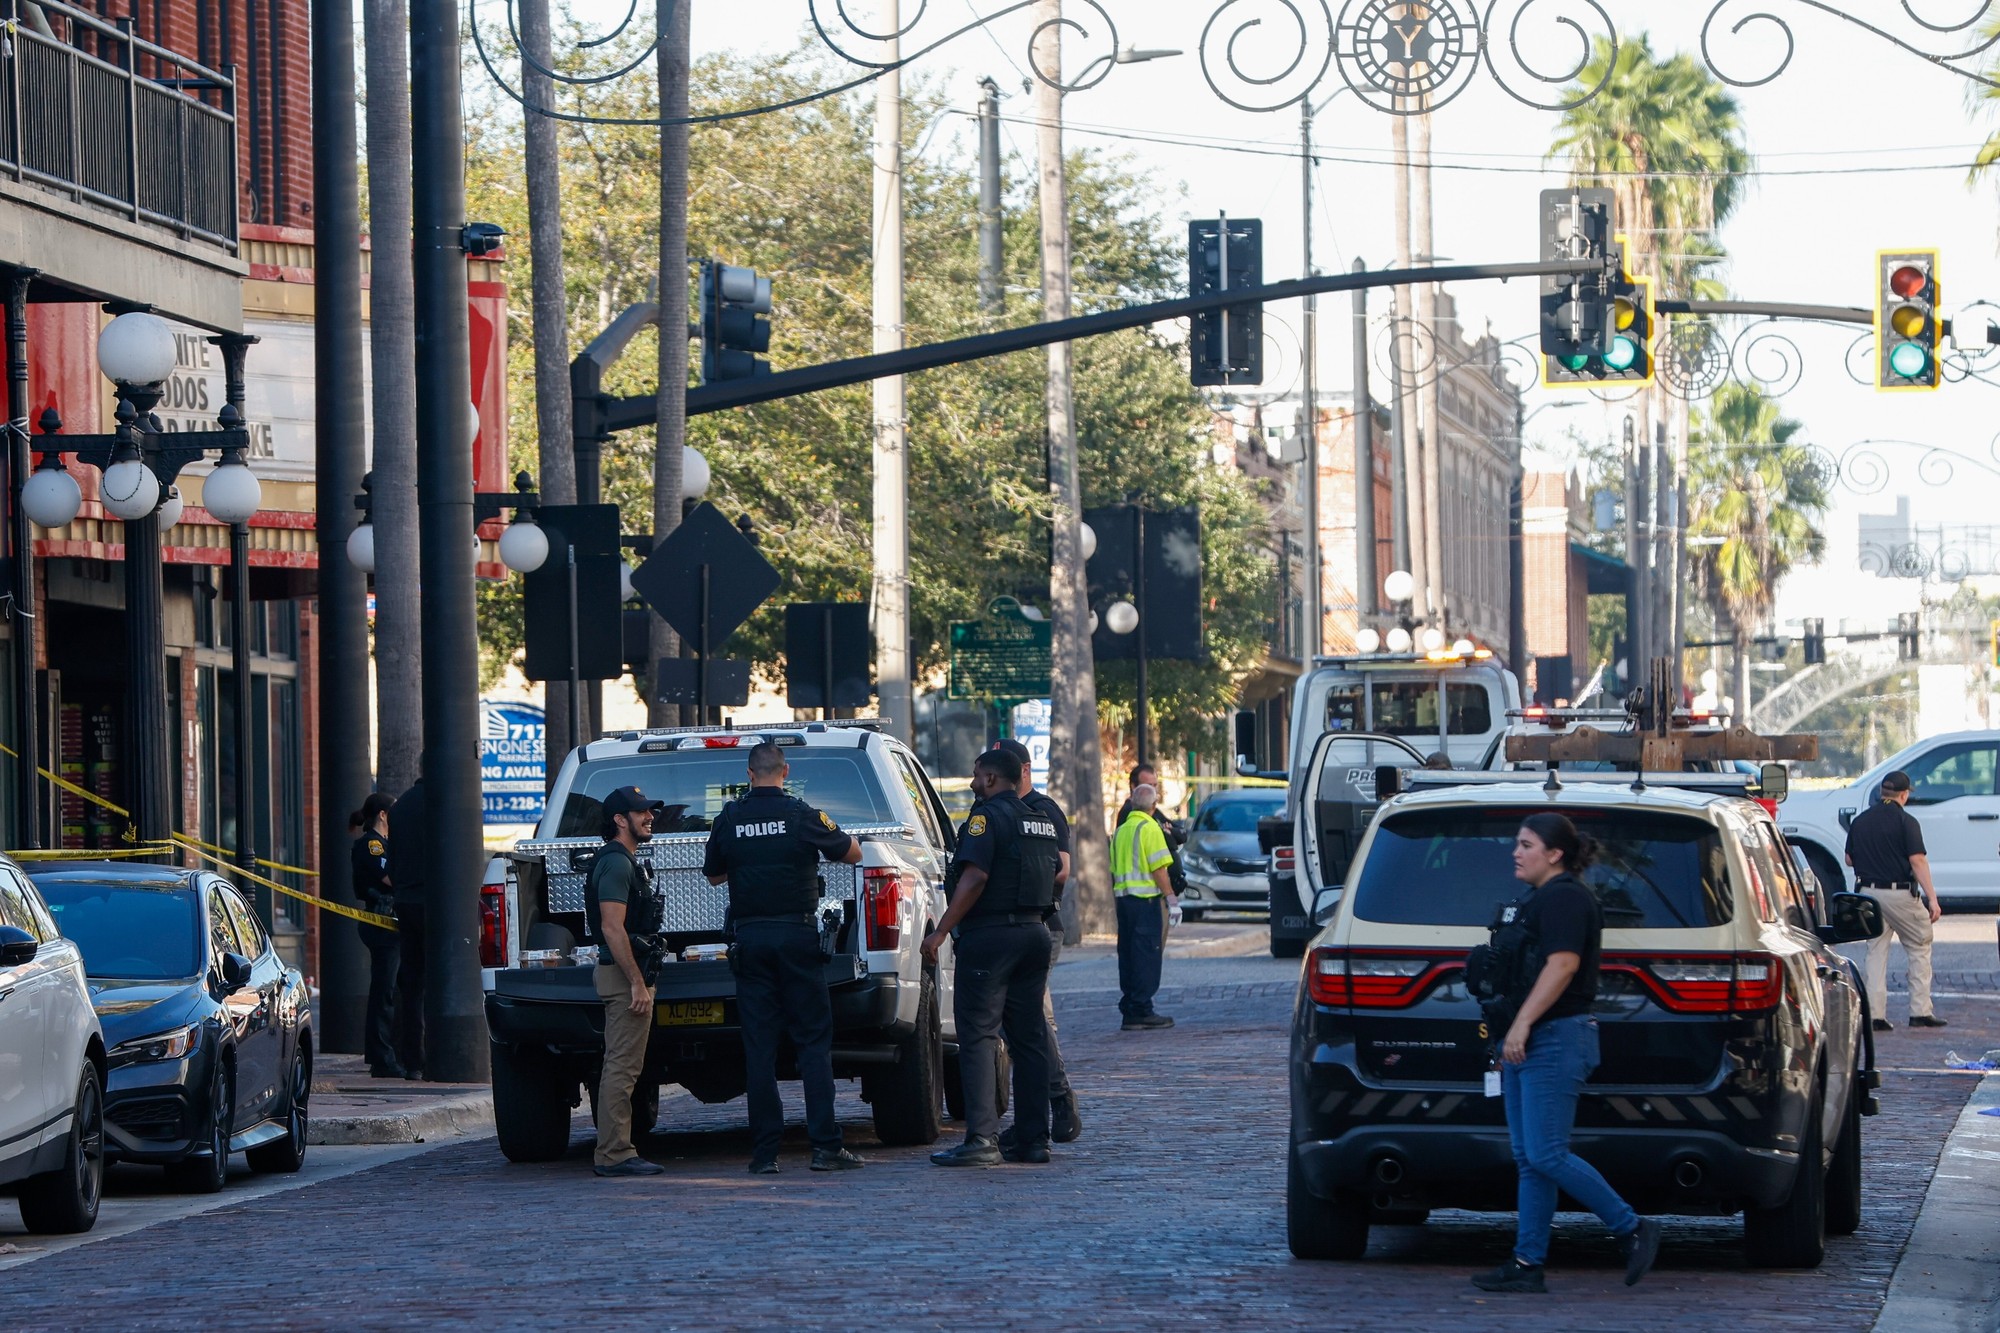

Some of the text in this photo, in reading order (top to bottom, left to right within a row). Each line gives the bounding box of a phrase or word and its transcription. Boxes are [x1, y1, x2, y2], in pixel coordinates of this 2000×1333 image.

[504, 766, 546, 779] AVAIL
[736, 821, 786, 838] POLICE
[1023, 821, 1056, 837] POLICE
